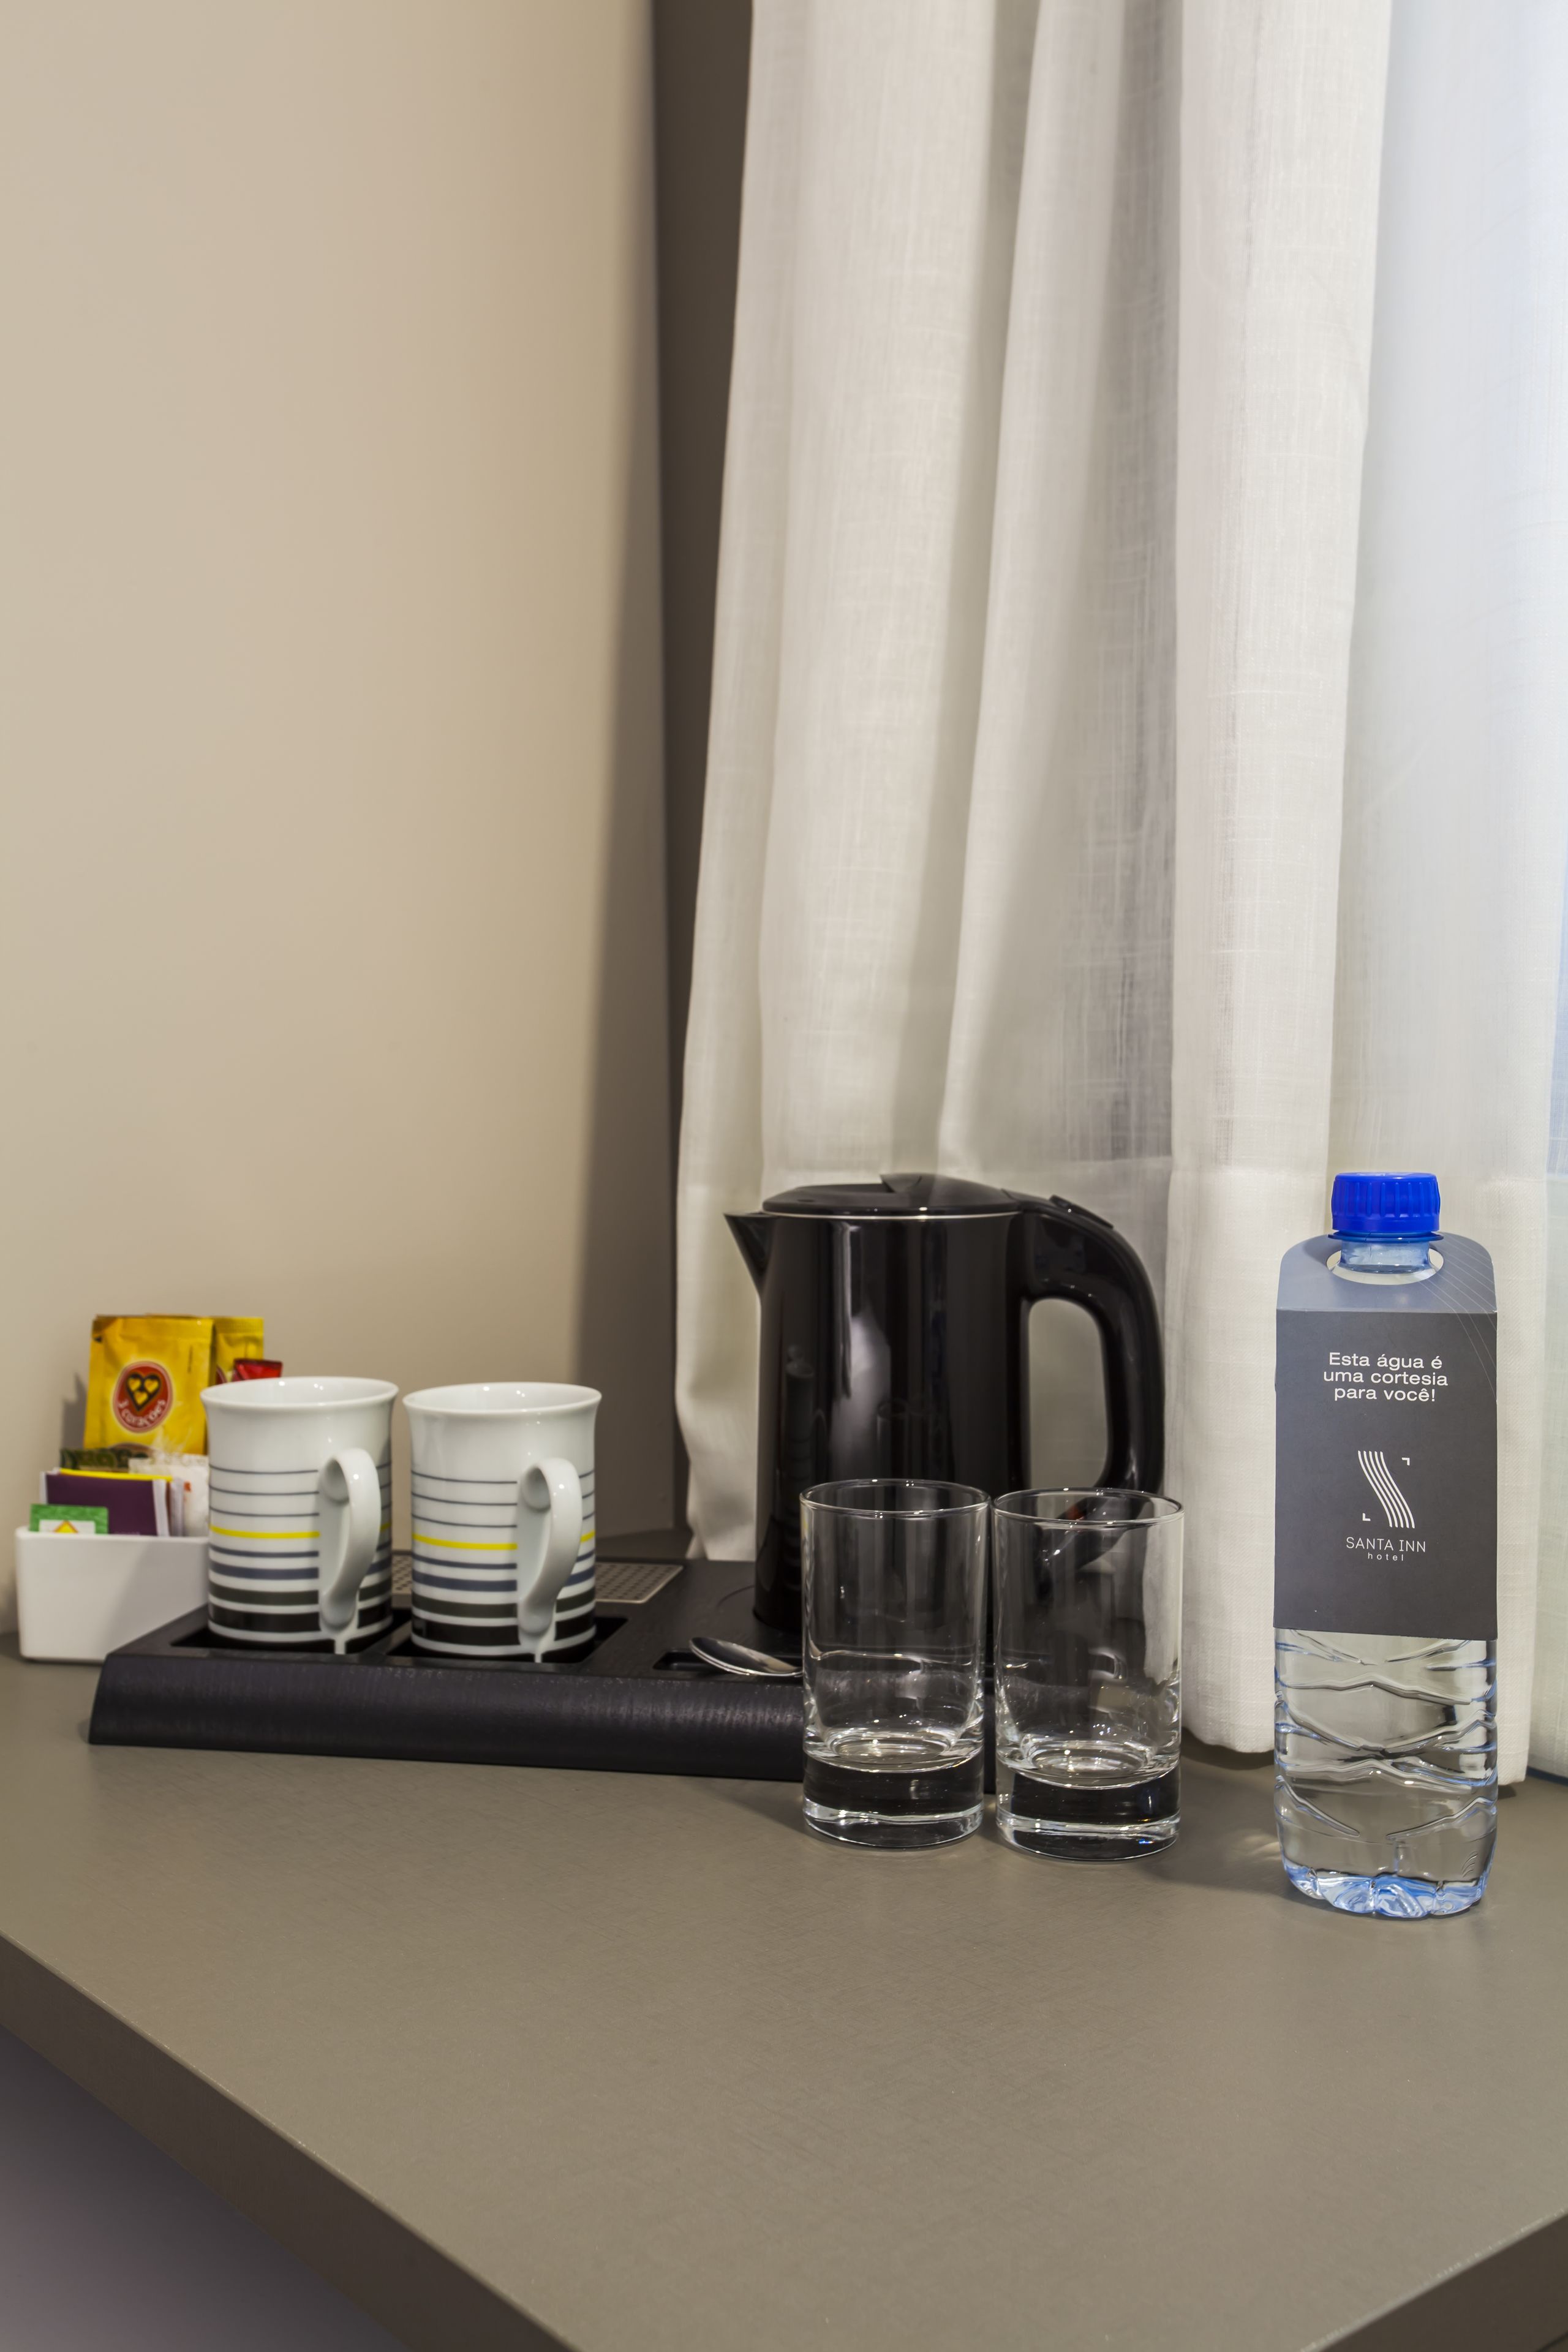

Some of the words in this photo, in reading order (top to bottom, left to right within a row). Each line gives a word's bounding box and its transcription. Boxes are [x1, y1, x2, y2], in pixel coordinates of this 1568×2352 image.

[1329, 1352, 1371, 1366] Esta
[1376, 1354, 1425, 1371] água
[1431, 1355, 1442, 1370] é
[1323, 1371, 1365, 1383] uma
[1370, 1372, 1449, 1386] cortesia
[1334, 1387, 1378, 1401] para
[1383, 1388, 1436, 1402] você!
[1346, 1536, 1394, 1551] SANTA
[1399, 1539, 1426, 1553] INN
[1368, 1552, 1404, 1561] hotel
